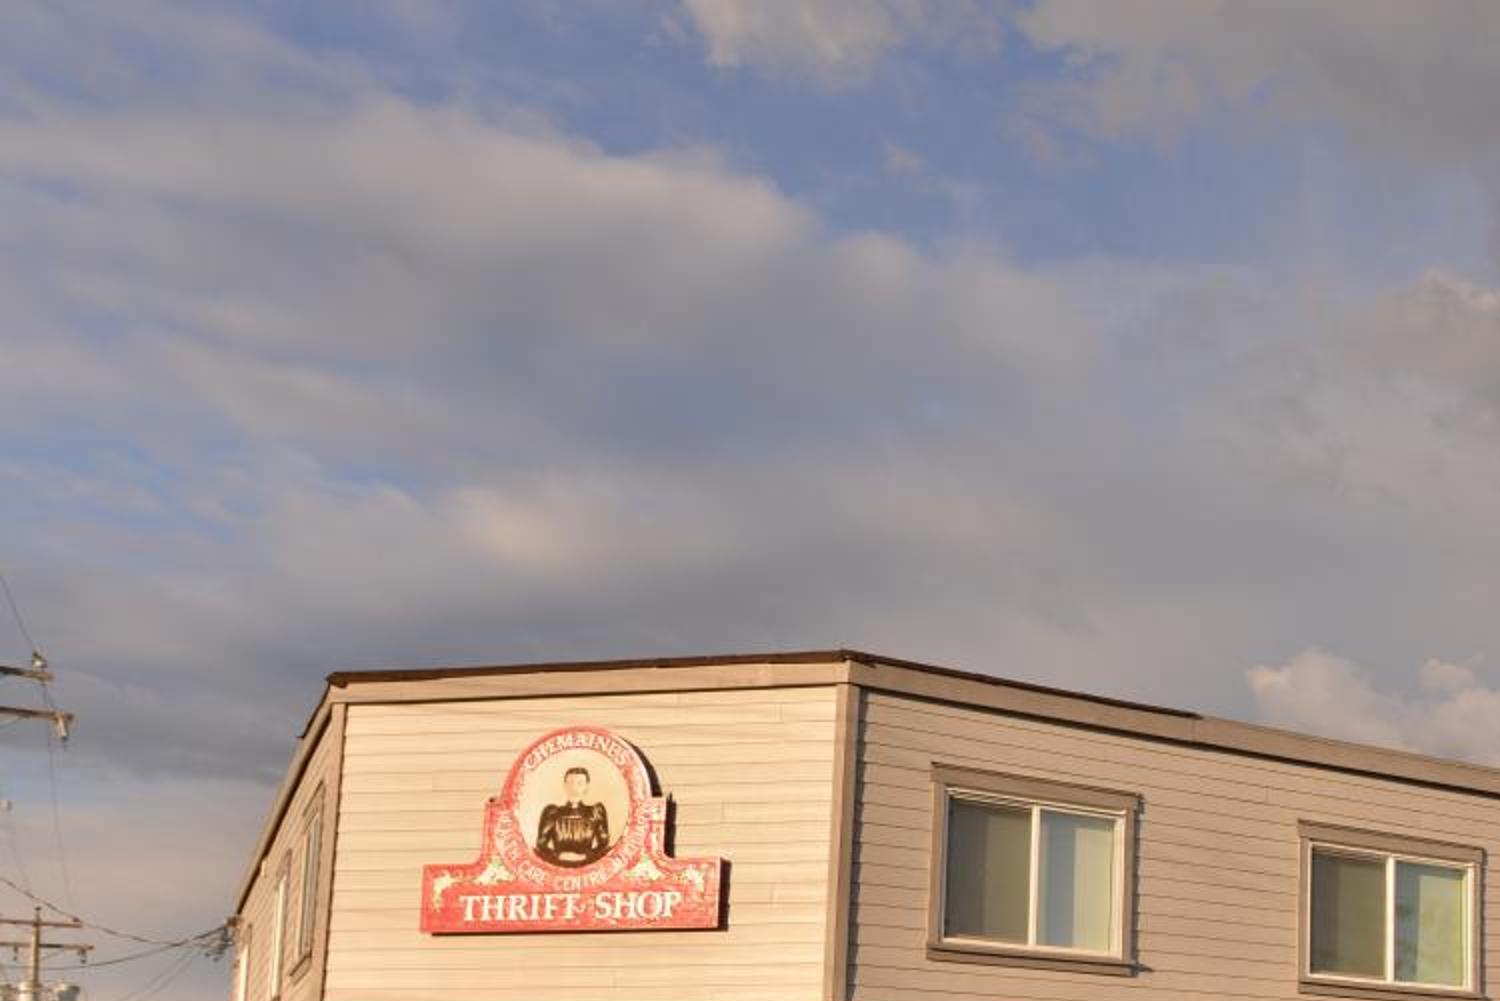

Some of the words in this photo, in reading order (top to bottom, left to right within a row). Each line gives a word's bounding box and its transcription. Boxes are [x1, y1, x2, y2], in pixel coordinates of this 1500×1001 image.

[526, 732, 632, 767] CHEMAINUS
[519, 860, 549, 886] CARE
[555, 869, 609, 892] CENTRE
[460, 893, 581, 921] THRIFT
[595, 892, 681, 920] SHOP
